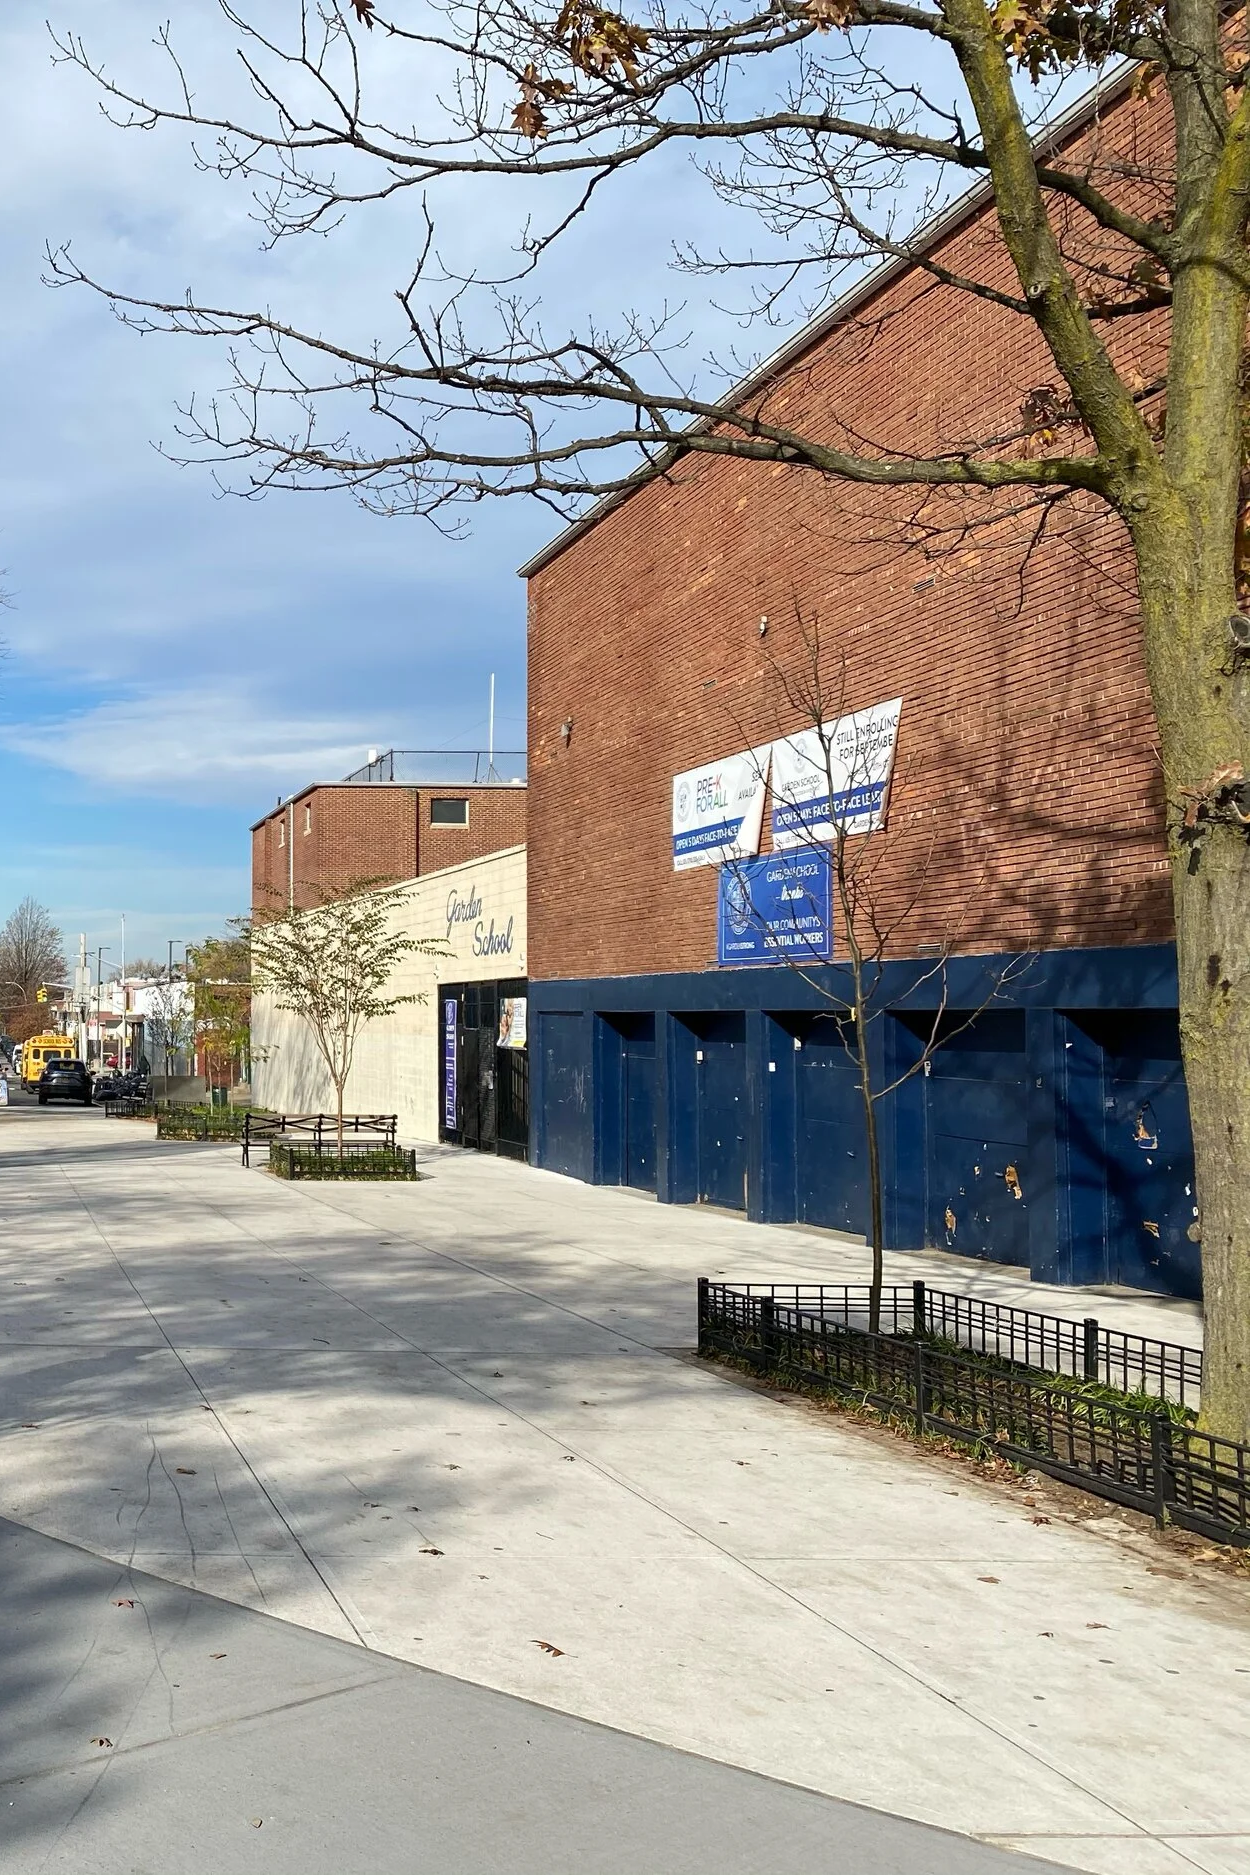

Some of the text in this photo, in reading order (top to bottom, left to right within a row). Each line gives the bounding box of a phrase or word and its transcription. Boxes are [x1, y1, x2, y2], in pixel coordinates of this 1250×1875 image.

[836, 715, 898, 745] STILL ENROLLING
[840, 746, 854, 759] FOR
[696, 773, 723, 797] PRE-K
[781, 780, 800, 792] GARDEN
[800, 774, 820, 787] SCHOOL
[696, 795, 714, 814] FOR
[713, 790, 729, 808] ALL
[776, 813, 792, 826] OPEN
[813, 795, 862, 817] FACEO-FACE
[676, 838, 688, 850] OPEN
[691, 833, 705, 847] DAYS
[704, 824, 738, 843] FACE-TO-FACE
[767, 863, 820, 882] GARDEN SCHOOL
[446, 885, 482, 938] Garden
[472, 915, 513, 957] School
[766, 920, 780, 932] OUR
[794, 931, 824, 945] WORKERS
